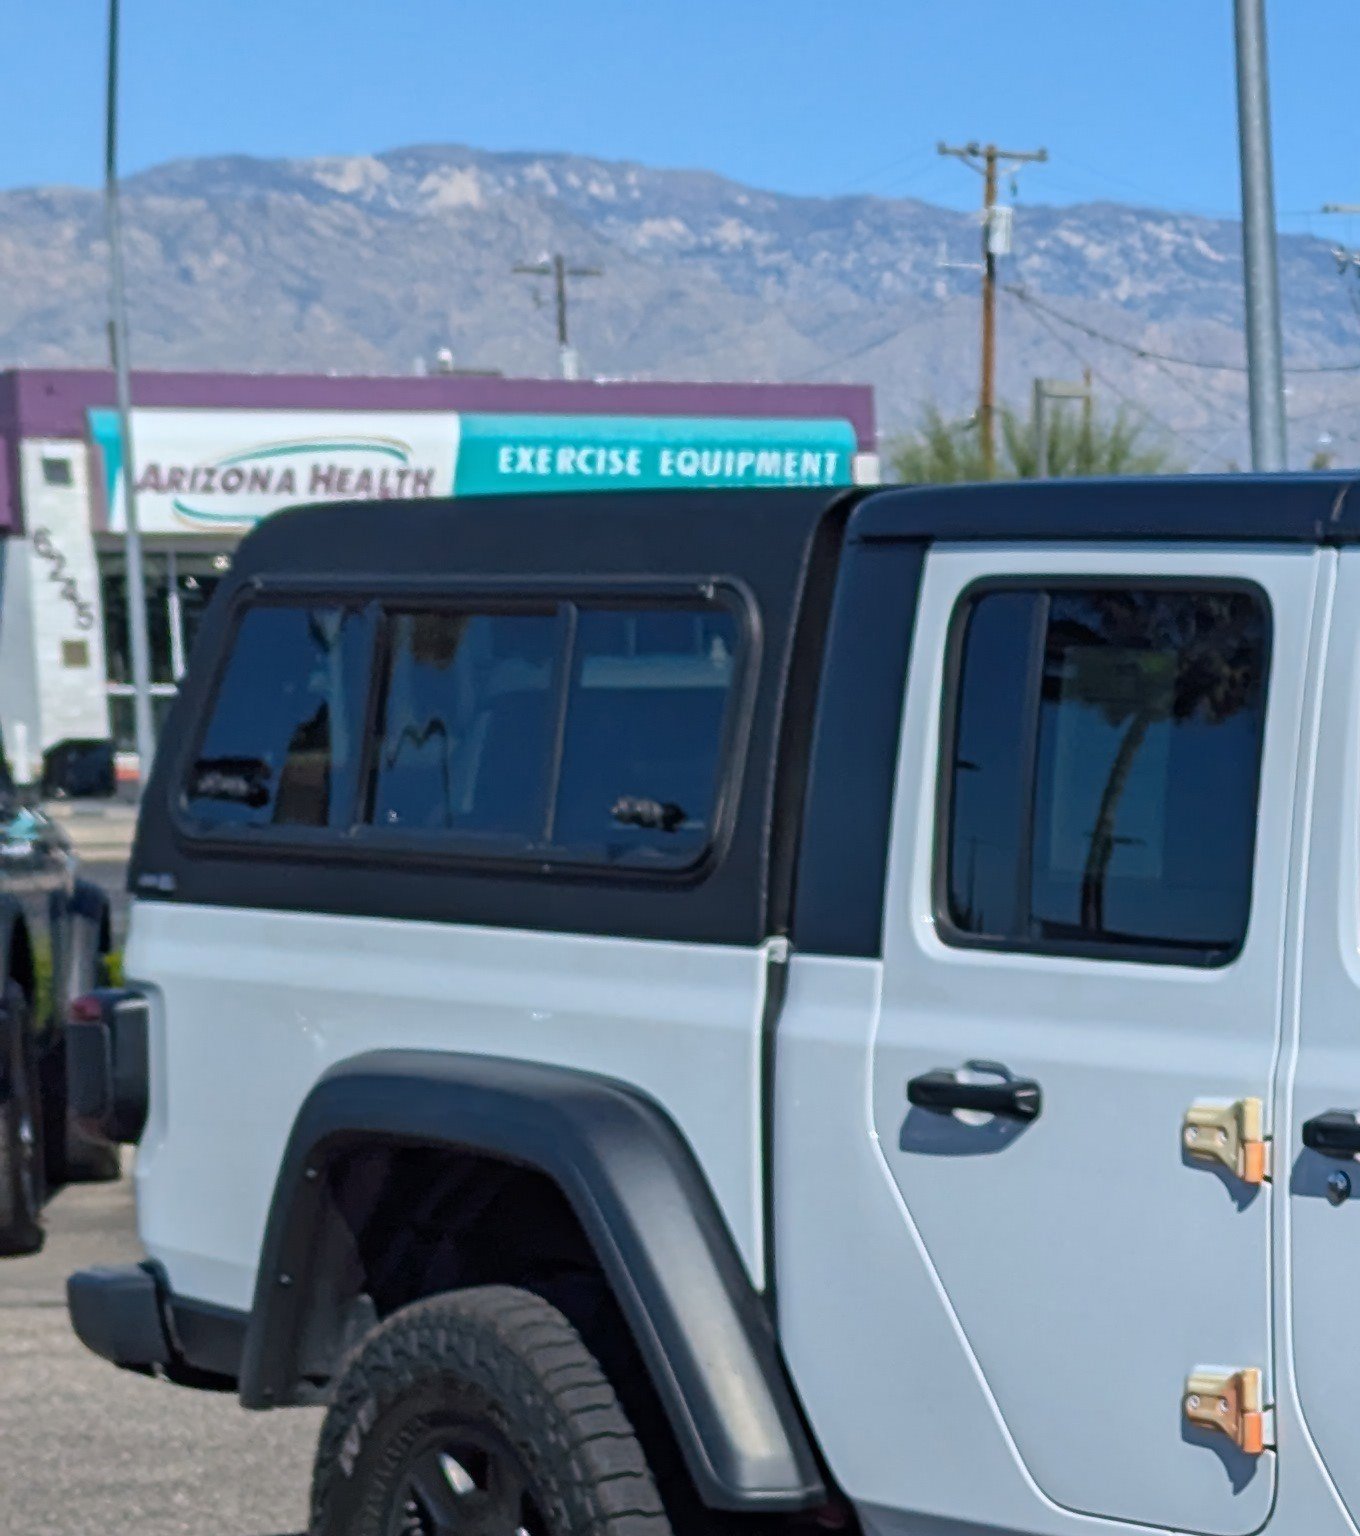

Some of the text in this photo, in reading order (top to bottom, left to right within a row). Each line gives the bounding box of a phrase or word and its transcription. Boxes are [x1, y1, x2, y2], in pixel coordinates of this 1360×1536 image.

[134, 462, 436, 497] ARIZONA HEALTH
[498, 446, 839, 479] EXERCISE EQUIPMENT
